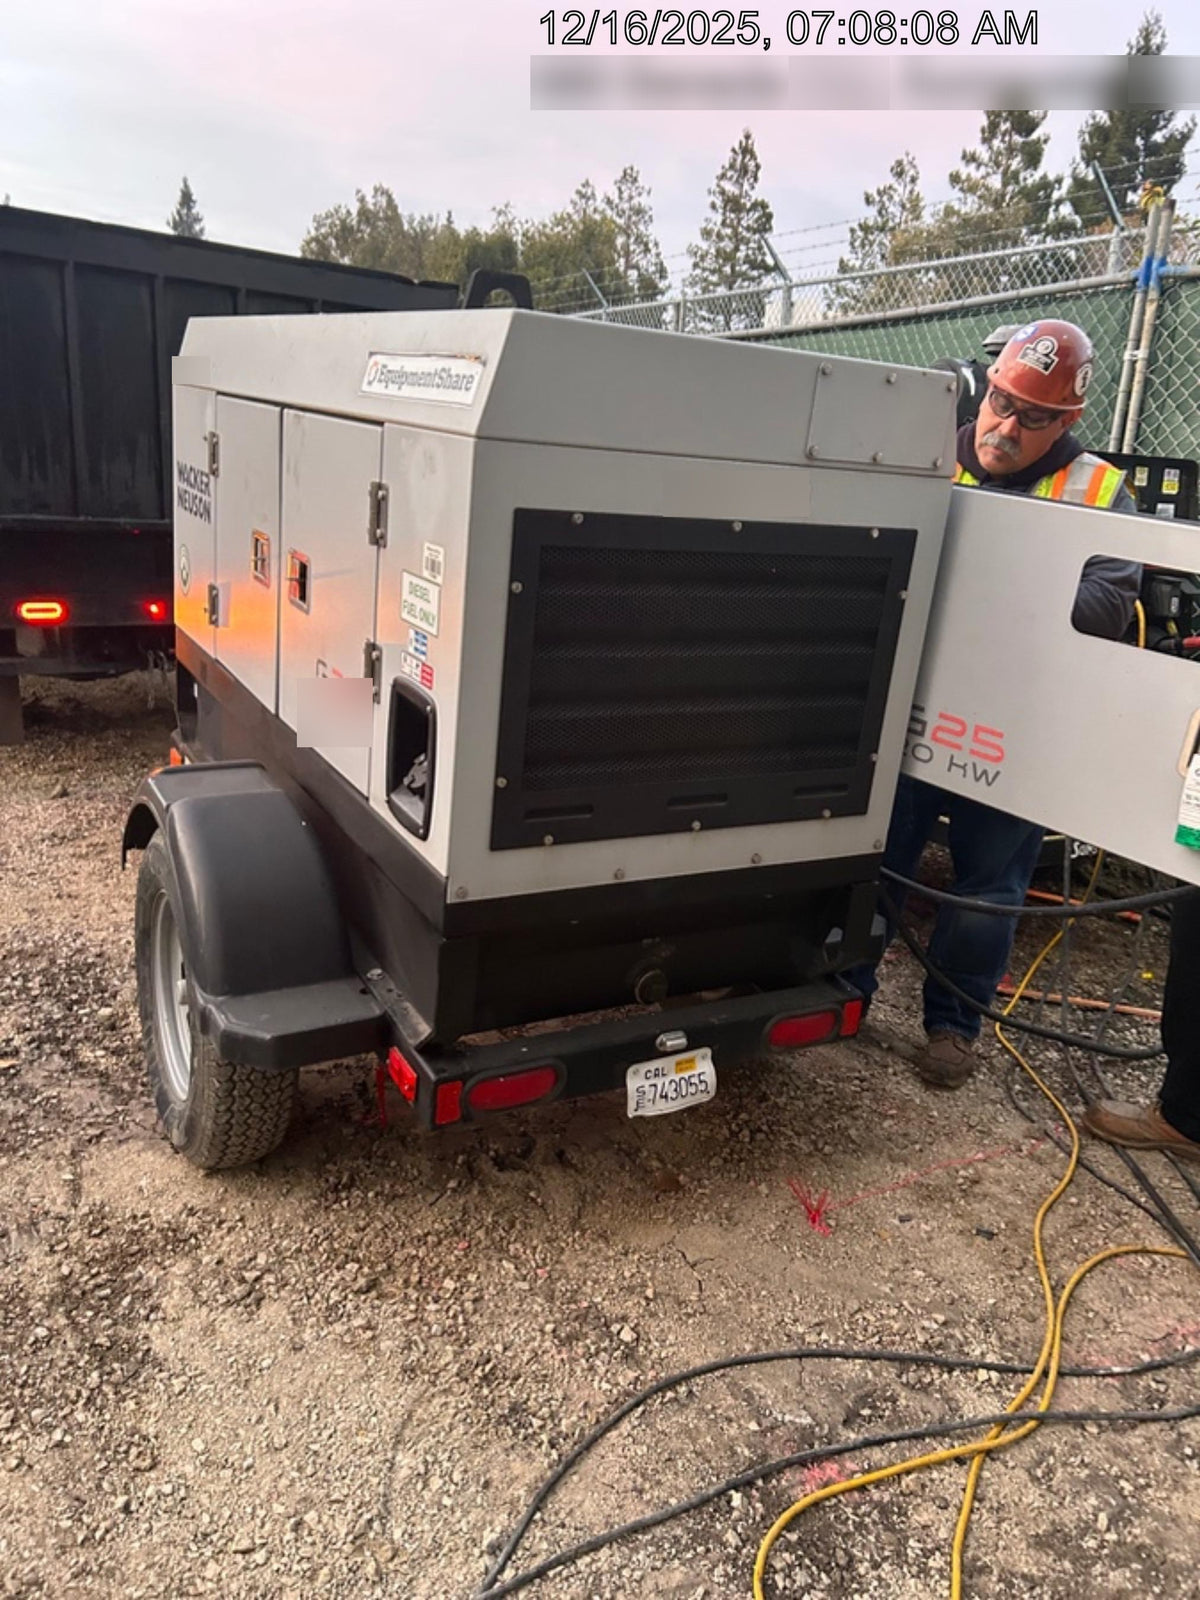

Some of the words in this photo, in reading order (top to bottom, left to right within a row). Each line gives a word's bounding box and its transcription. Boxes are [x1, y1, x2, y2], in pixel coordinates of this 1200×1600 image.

[376, 364, 475, 393] EquipmentShare
[177, 461, 211, 498] WACKER
[177, 486, 211, 525] NEUSON
[408, 580, 431, 604] DIESEL
[402, 599, 418, 619] FUEL
[419, 607, 436, 629] ONLY
[644, 1067, 667, 1080] CAL
